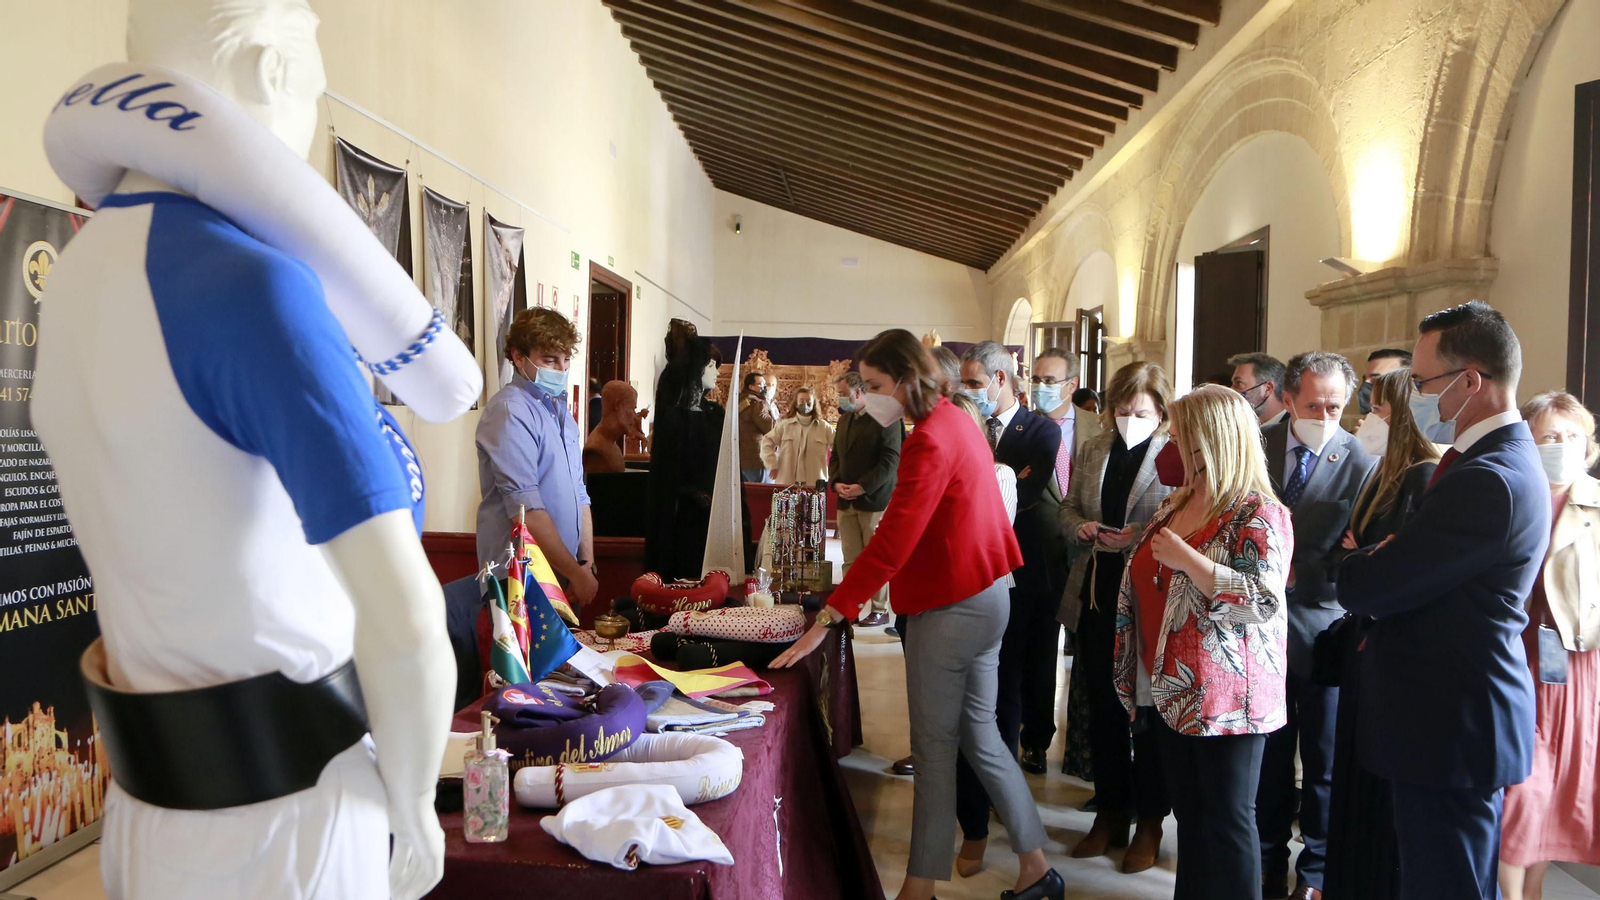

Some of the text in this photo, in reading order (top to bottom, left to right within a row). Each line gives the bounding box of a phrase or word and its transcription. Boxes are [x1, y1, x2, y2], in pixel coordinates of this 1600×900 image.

[52, 73, 203, 131] ella
[1, 443, 46, 452] Y MORCILLA
[19, 458, 27, 467] DE
[5, 486, 38, 497] ESCUDOS
[40, 486, 45, 494] &
[20, 501, 38, 510] PARA
[40, 500, 48, 509] EL
[19, 514, 52, 525] NORMALES
[13, 525, 72, 541] FAJÍN DE ESPARTO
[25, 541, 50, 553] PEINAS
[51, 541, 56, 549] &
[29, 583, 55, 600] CON
[57, 575, 92, 594] PASIÓN
[669, 596, 713, 613] Homo
[559, 733, 588, 764] del
[589, 725, 632, 759] Amor
